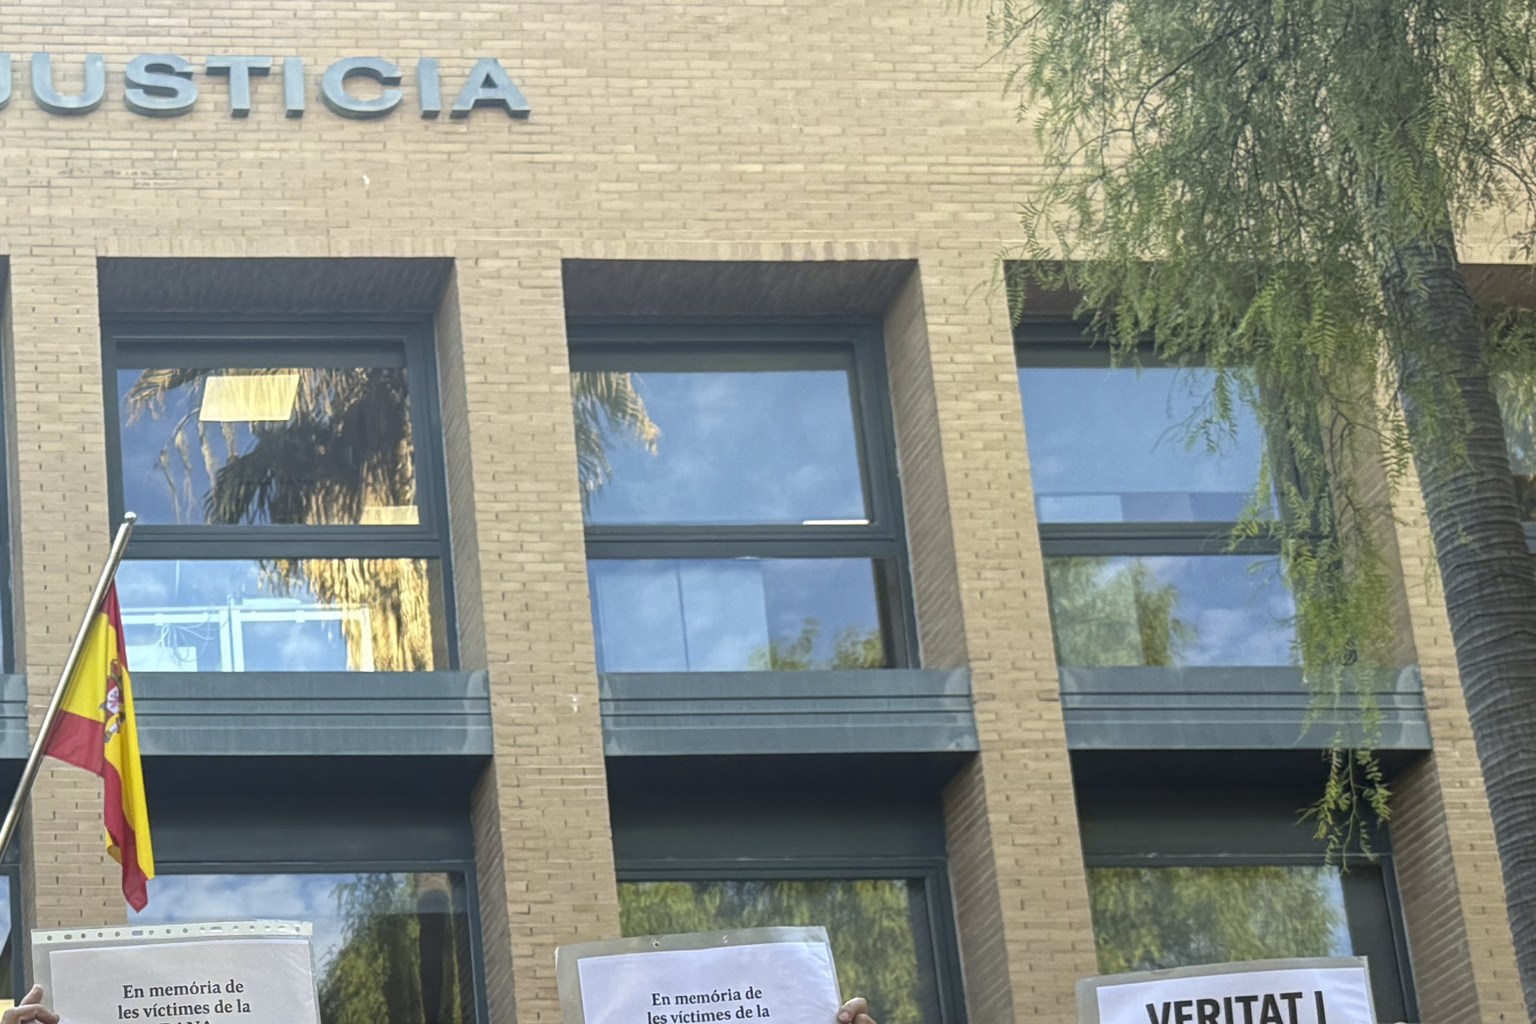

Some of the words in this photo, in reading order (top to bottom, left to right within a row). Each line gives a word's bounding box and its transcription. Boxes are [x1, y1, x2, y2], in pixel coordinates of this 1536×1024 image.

[122, 984, 145, 999] En
[149, 981, 222, 998] memória
[225, 978, 244, 994] de
[651, 992, 671, 1006] En
[674, 988, 742, 1005] memória
[745, 985, 762, 1000] de
[117, 1004, 140, 1020] les
[142, 1001, 210, 1018] víctimes
[214, 999, 233, 1014] de
[236, 998, 251, 1013] la
[647, 1011, 668, 1024] les
[670, 1010, 732, 1024] víctimes
[735, 1005, 753, 1020] de
[756, 1004, 770, 1018] la
